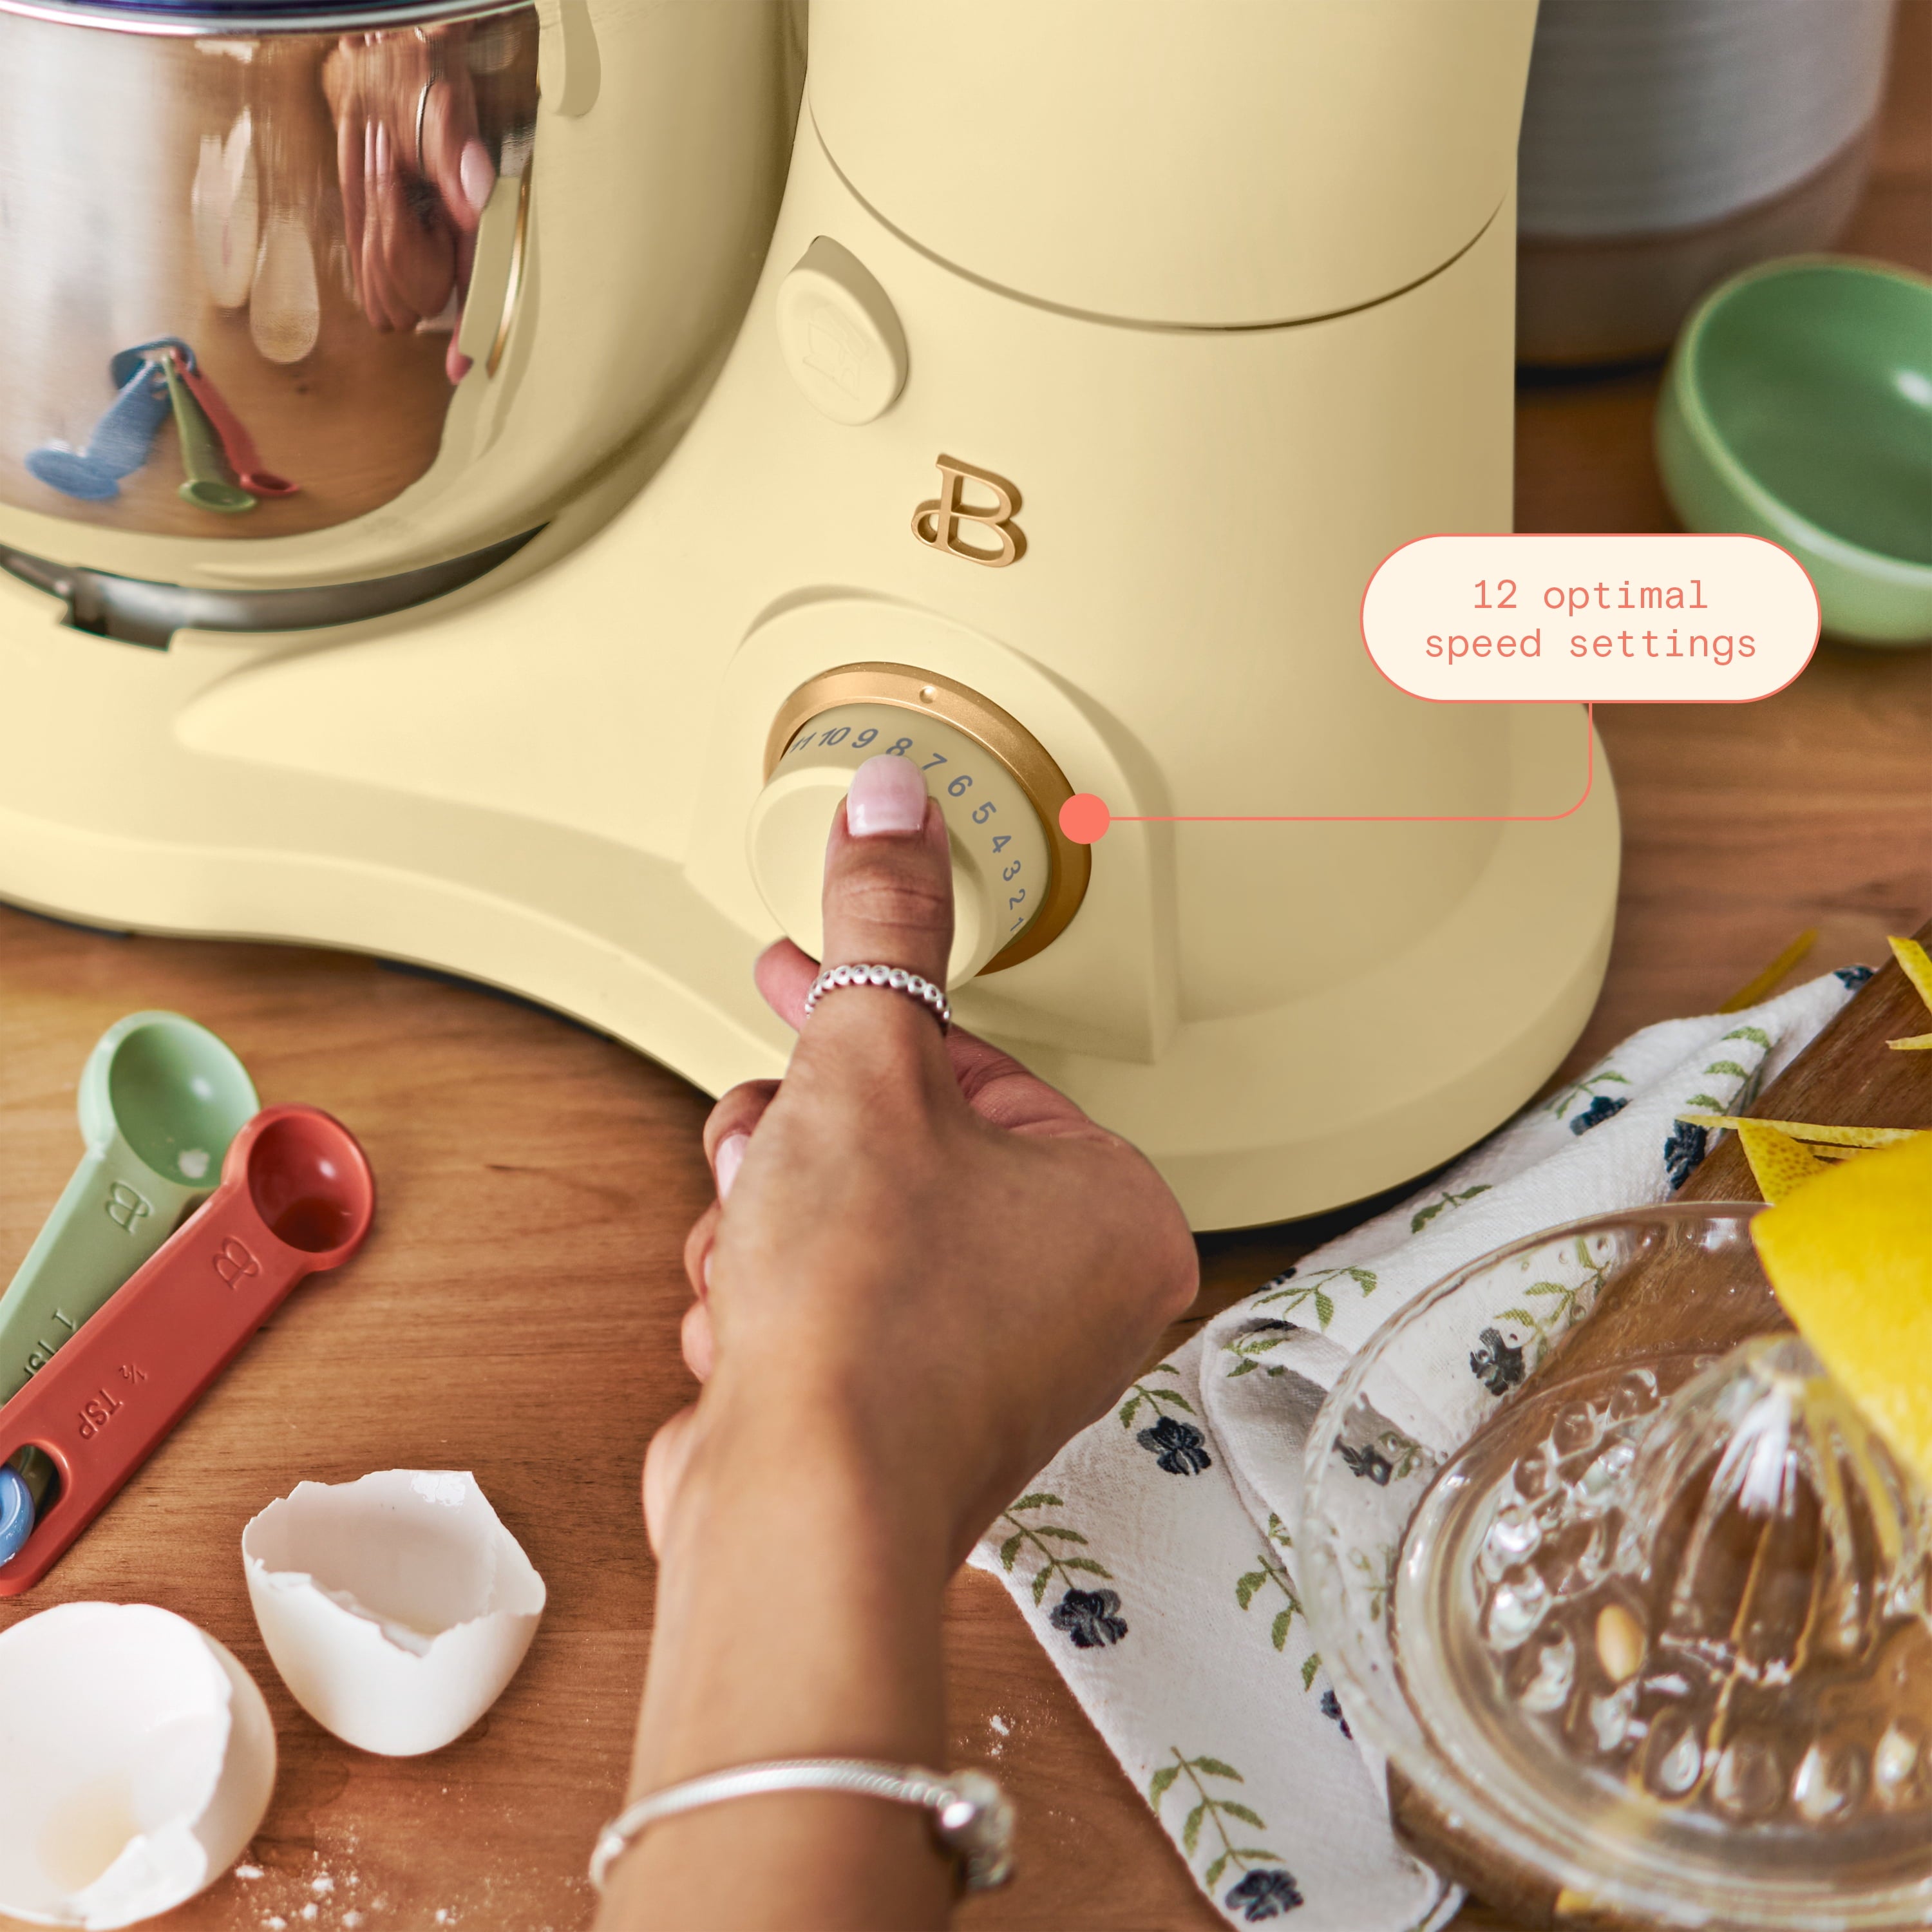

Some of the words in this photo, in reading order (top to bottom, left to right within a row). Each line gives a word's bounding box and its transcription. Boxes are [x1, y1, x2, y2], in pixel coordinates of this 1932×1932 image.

[911, 453, 1028, 568] B
[790, 732, 817, 753] 11
[819, 727, 851, 746] 10
[852, 728, 878, 748] 9
[922, 753, 947, 770] 7
[948, 775, 973, 797] 6
[972, 801, 997, 824] 5
[992, 835, 1012, 853] 4
[1003, 860, 1021, 882] 3
[1009, 888, 1026, 911] 2
[1010, 917, 1024, 932] 1
[78, 1388, 124, 1440] TSP
